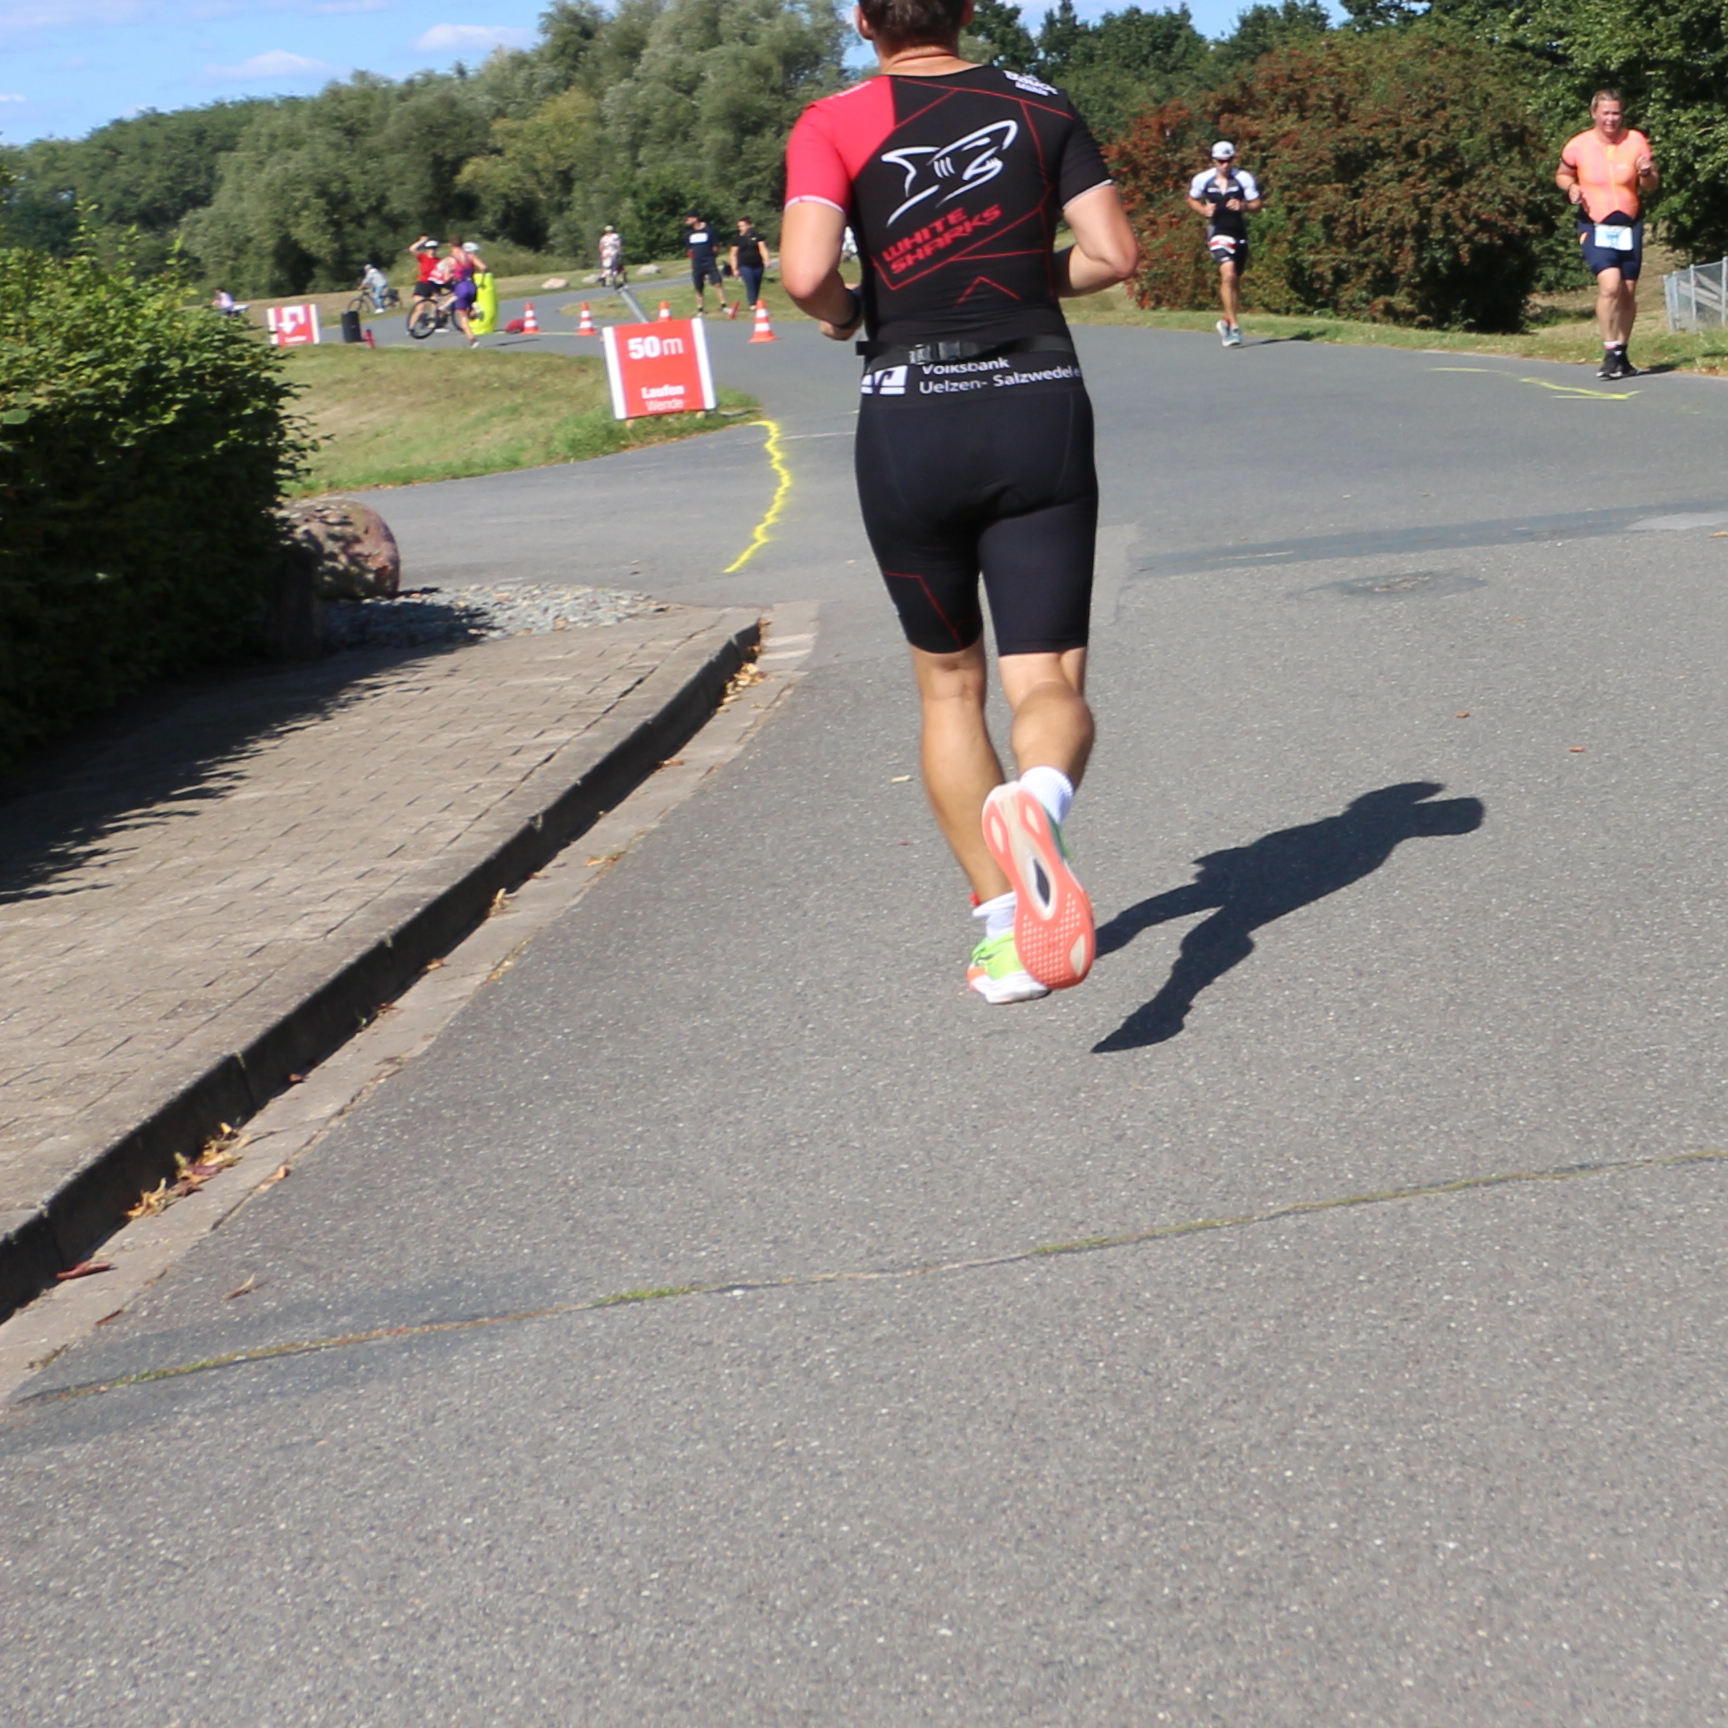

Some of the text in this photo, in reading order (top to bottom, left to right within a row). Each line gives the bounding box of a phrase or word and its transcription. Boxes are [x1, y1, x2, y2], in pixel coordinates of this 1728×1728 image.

[881, 206, 968, 262] WHITE
[890, 203, 1003, 274] SHARKS
[641, 384, 685, 399] Laufen
[919, 380, 988, 395] Uelzen-
[992, 364, 1074, 388] Salzwedel
[645, 398, 685, 411] Wende
